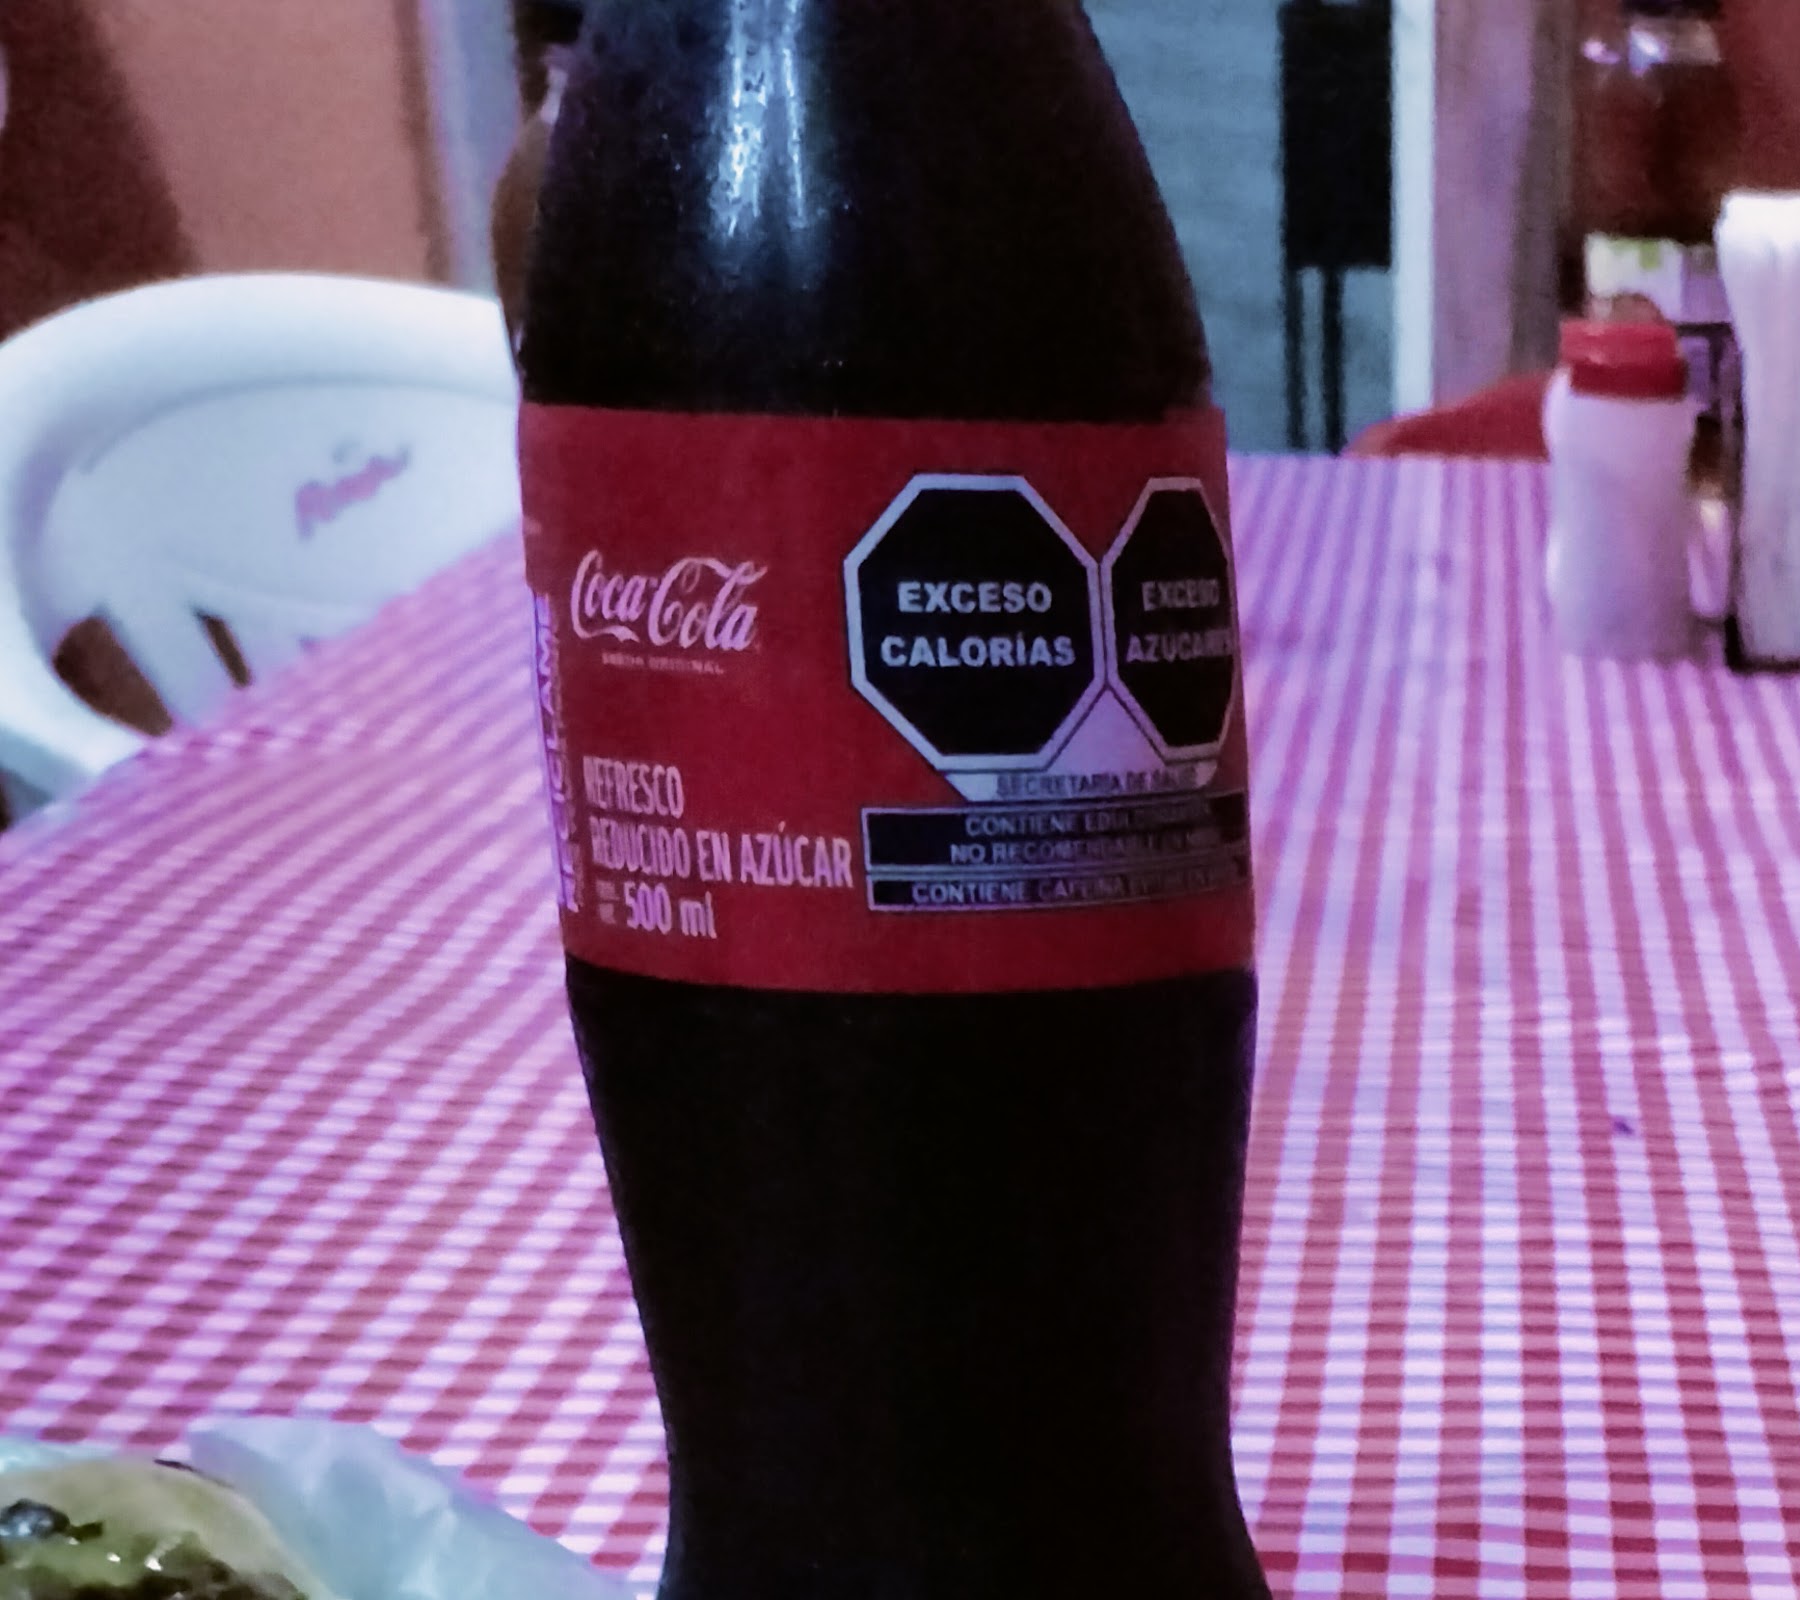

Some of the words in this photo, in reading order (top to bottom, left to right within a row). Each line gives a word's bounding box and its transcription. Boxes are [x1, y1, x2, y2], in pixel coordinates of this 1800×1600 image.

[571, 550, 768, 651] Coca-Cola
[898, 580, 1052, 613] EXCESO
[881, 630, 1076, 667] CALORÍAS
[583, 756, 684, 819] REFRESCO
[590, 816, 691, 879] REDUCIDO
[696, 828, 732, 883] EN
[740, 820, 853, 888] AZÚCAR
[950, 843, 985, 864] NO
[623, 881, 672, 935] 500
[679, 890, 717, 939] ml
